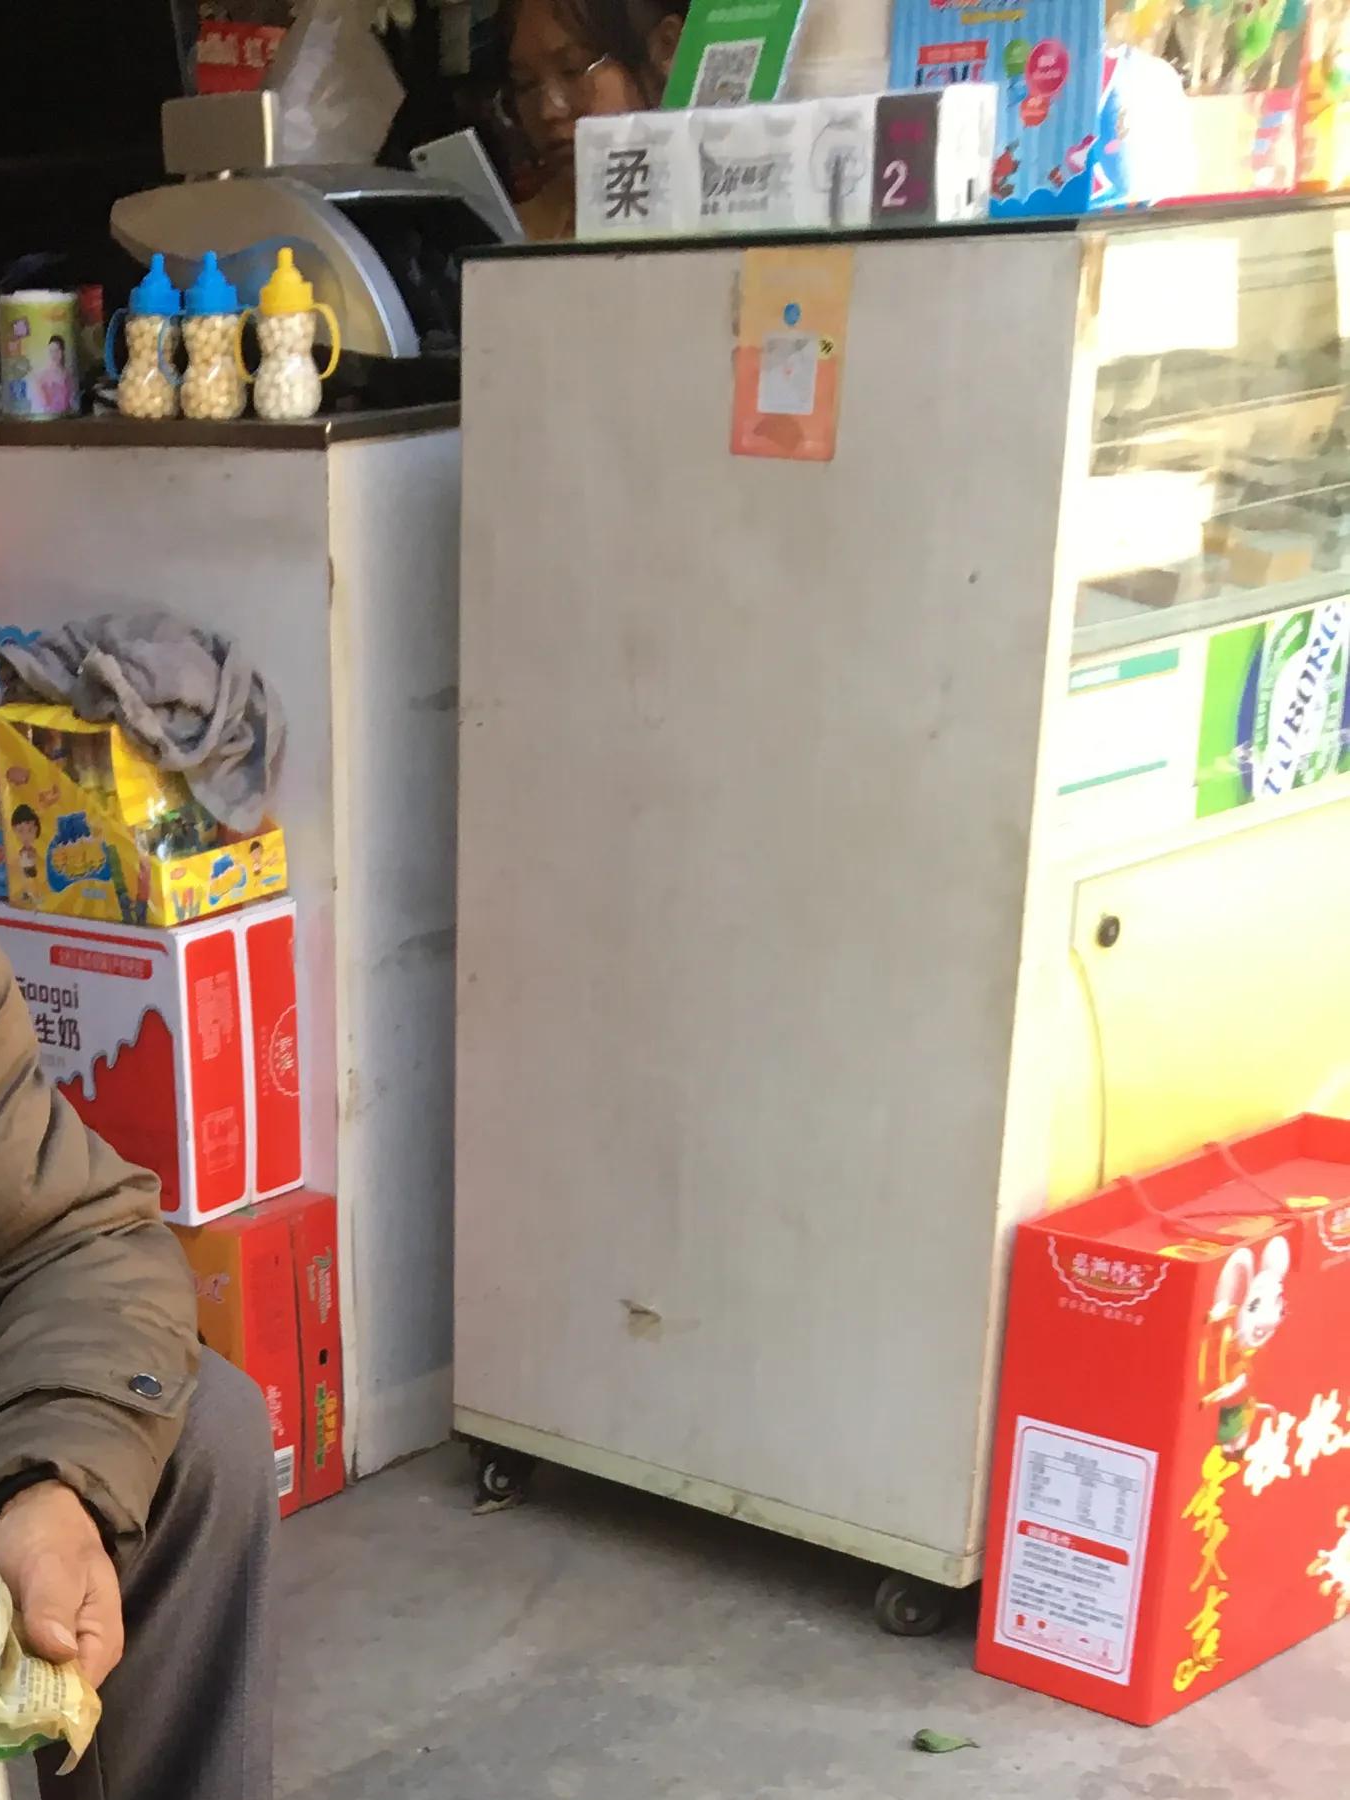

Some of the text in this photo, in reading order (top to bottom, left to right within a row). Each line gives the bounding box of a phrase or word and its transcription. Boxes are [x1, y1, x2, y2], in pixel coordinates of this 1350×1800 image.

[606, 149, 649, 218] 柔
[882, 159, 909, 208] 2
[35, 1012, 81, 1051] 生奶
